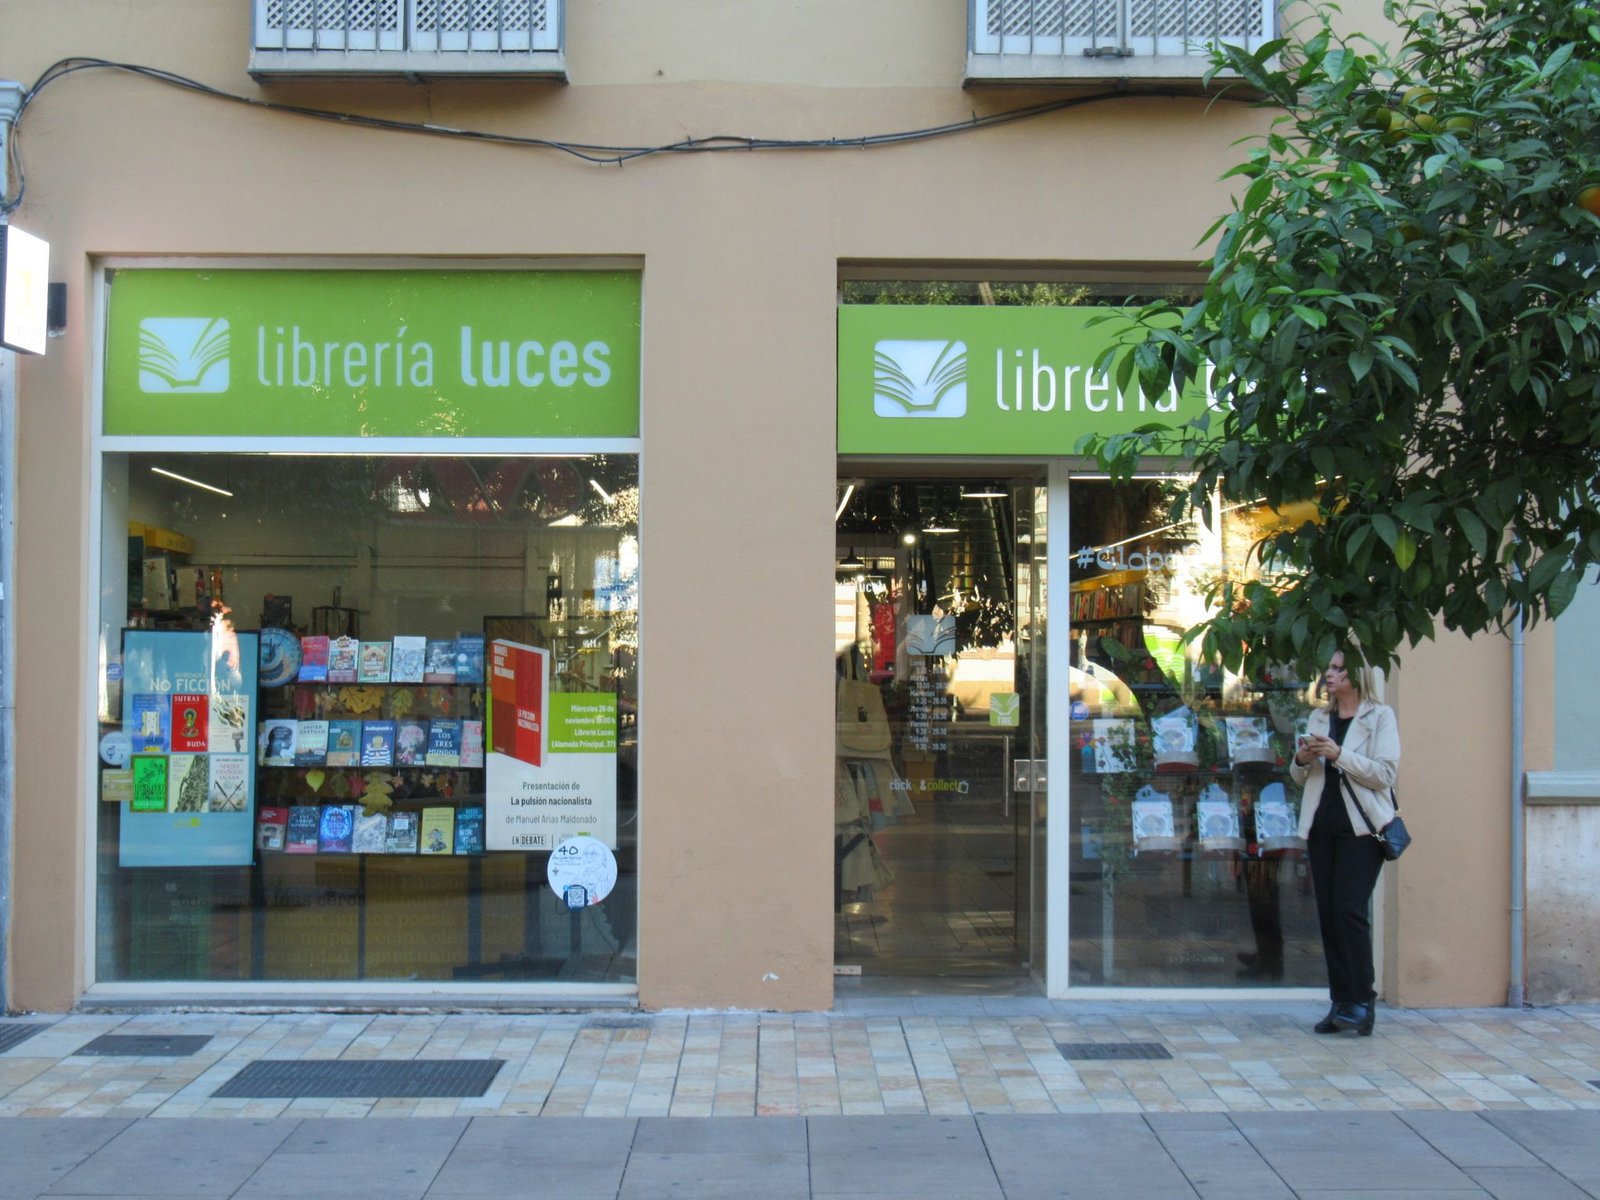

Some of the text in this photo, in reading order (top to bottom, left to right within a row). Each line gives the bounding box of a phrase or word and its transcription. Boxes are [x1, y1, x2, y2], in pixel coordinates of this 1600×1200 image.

[257, 325, 612, 388] librería luces
[150, 678, 172, 692] NO
[434, 740, 453, 748] TRES
[522, 781, 580, 791] Presentación de
[889, 778, 912, 791] click
[510, 796, 592, 807] La pulsión nacionalista
[505, 814, 597, 824] de Manuel Arias Maldonado
[512, 835, 545, 845] EN DEBATE
[558, 845, 579, 855] 40
